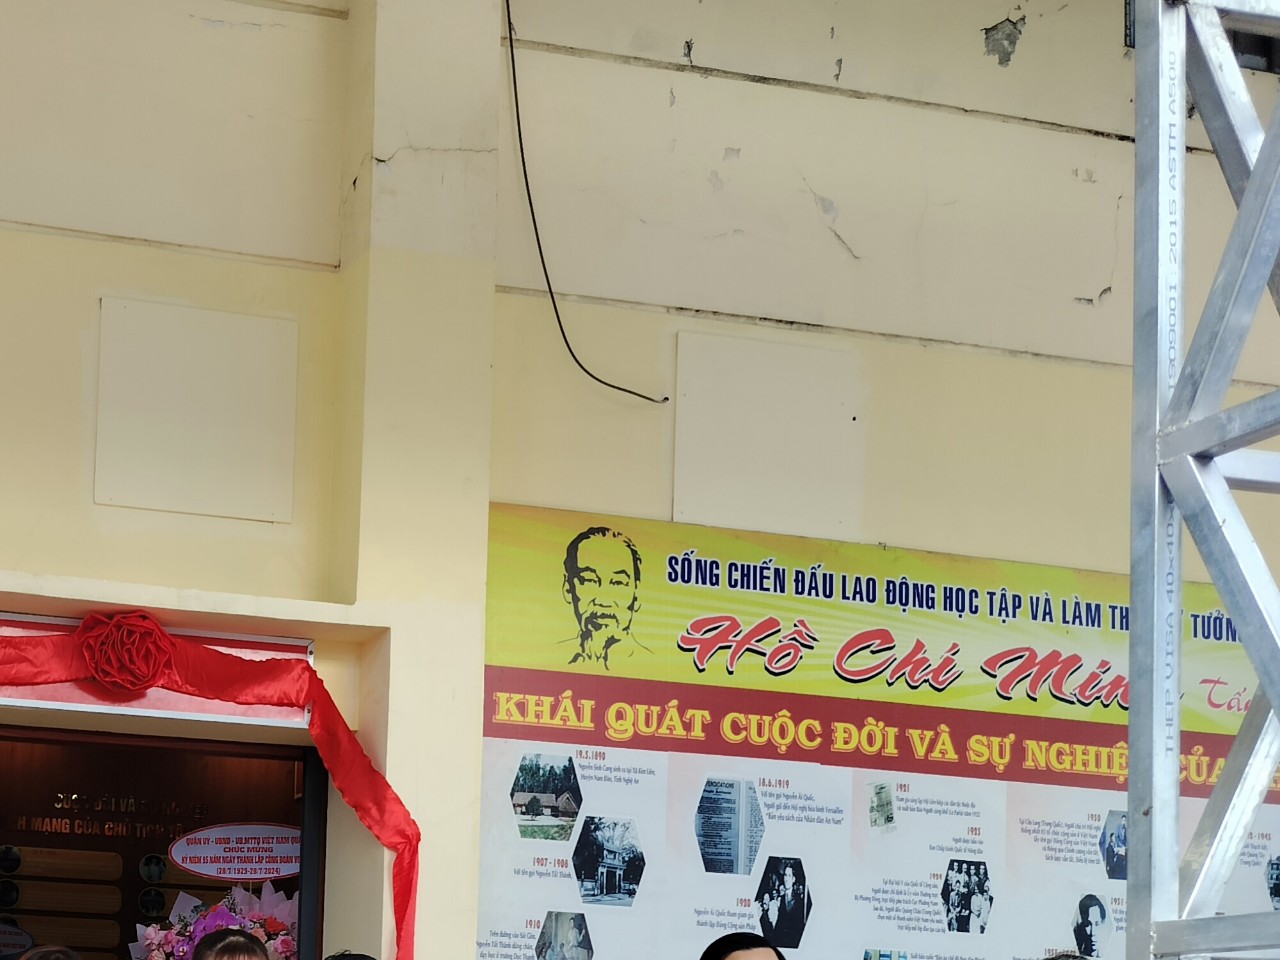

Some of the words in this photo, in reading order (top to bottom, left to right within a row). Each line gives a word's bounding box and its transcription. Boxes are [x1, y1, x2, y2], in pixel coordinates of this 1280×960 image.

[1168, 50, 1177, 116] A500
[1168, 123, 1177, 192] ASTM
[1168, 199, 1177, 264] 2015
[668, 550, 720, 587] SỐNG
[728, 559, 786, 594] CHIẾN
[794, 564, 834, 599] ĐẤU
[841, 575, 877, 604] LAO
[885, 576, 935, 613] ĐỘNG
[943, 586, 979, 618] HỌC
[986, 587, 1022, 623] TẬP
[1029, 592, 1054, 623] VÀ
[1062, 596, 1102, 628] LÀM
[1190, 610, 1243, 643] TƯỞN
[678, 615, 819, 676] Hồ
[833, 628, 963, 693] Chí
[981, 646, 1129, 706] Min
[1199, 677, 1251, 713] Tấ
[493, 690, 595, 730] KHÁI
[605, 699, 712, 741] QUÁT
[720, 709, 822, 754] CUỘC
[831, 717, 899, 757] ĐỜI
[906, 723, 959, 762] VÀ
[967, 733, 1015, 773] SỰ
[1023, 740, 1129, 784] NGHIỆ
[575, 749, 606, 761] 19.5.1890
[758, 777, 790, 789] 18.6.1919
[31, 817, 70, 835] MẠNG
[74, 816, 100, 835] CỦA
[223, 846, 245, 854] CHÚC
[525, 919, 541, 929] 1910
